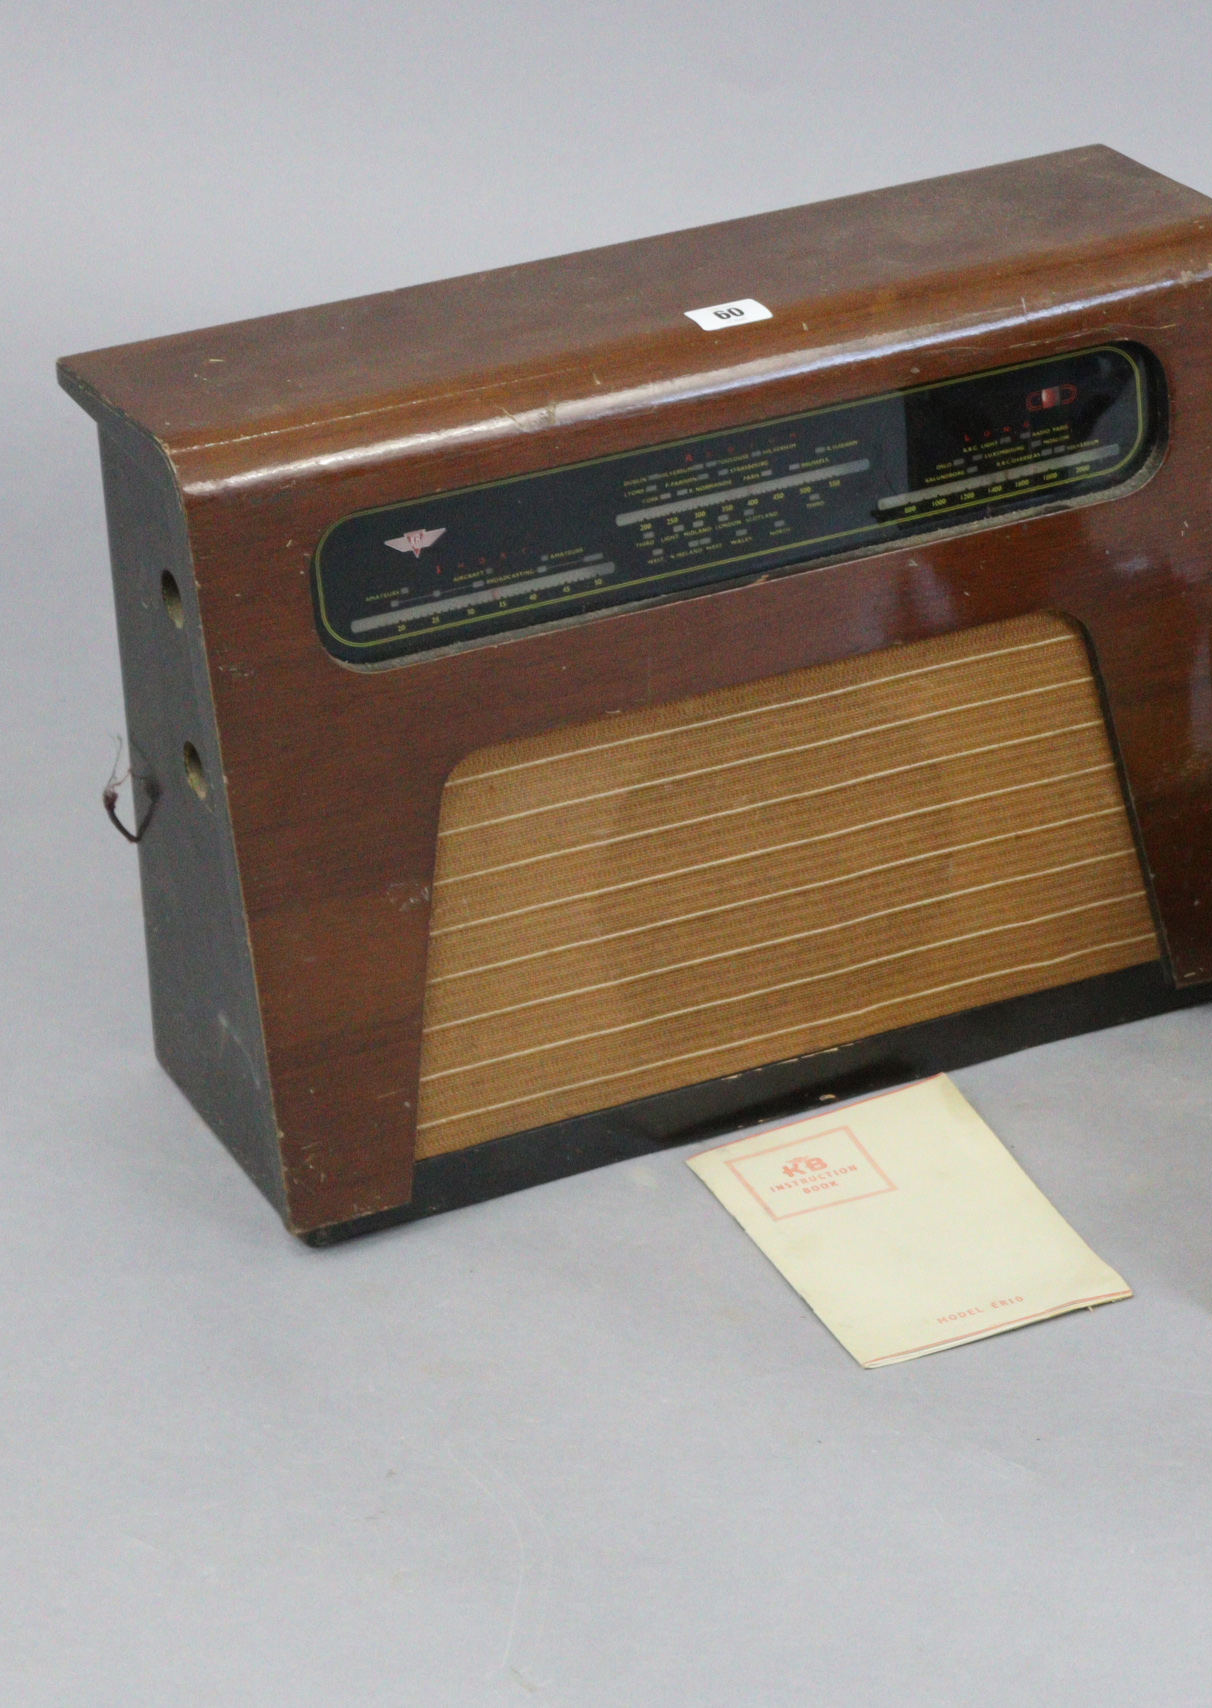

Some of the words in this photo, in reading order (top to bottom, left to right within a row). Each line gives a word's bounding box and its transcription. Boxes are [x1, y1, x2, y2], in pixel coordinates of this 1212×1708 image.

[713, 307, 745, 319] 60
[782, 1157, 828, 1178] KB
[770, 1164, 858, 1192] INSTRUCTION
[802, 1180, 839, 1194] BOOK
[936, 1307, 984, 1325] MODEL
